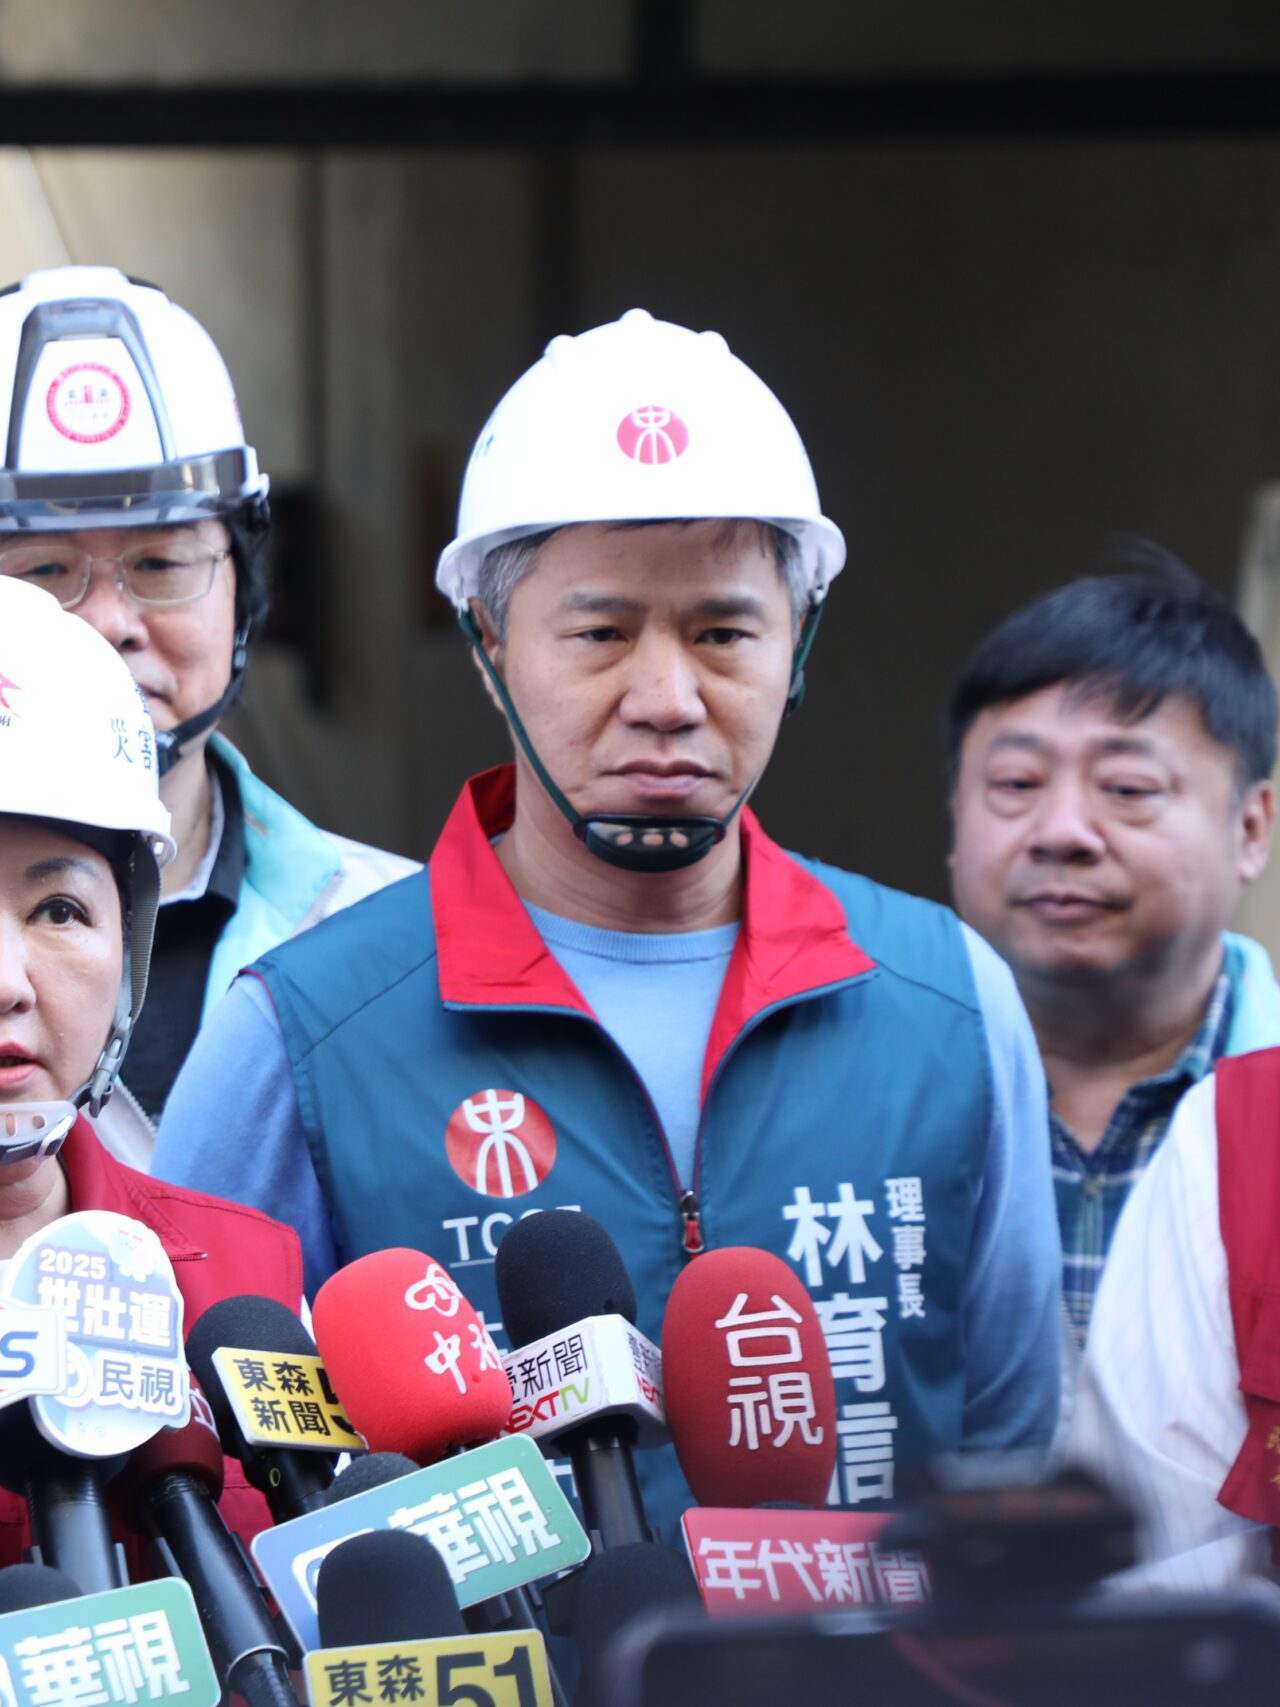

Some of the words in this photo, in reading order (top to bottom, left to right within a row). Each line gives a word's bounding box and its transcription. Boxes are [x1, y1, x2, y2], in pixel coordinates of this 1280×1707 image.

[38, 1248, 107, 1281] 2025
[441, 1204, 582, 1262] TC
[884, 1176, 927, 1320] 理事長
[714, 1292, 825, 1451] 台視
[781, 1182, 898, 1506] 林育信
[99, 1358, 177, 1408] 民視
[232, 1357, 315, 1397] 東森
[250, 1396, 331, 1437] 新聞
[387, 1465, 562, 1585] 華視
[698, 1537, 932, 1603] 年代新聞
[13, 1609, 191, 1707] 華視
[324, 1654, 426, 1707] 東森
[435, 1646, 538, 1707] 51
